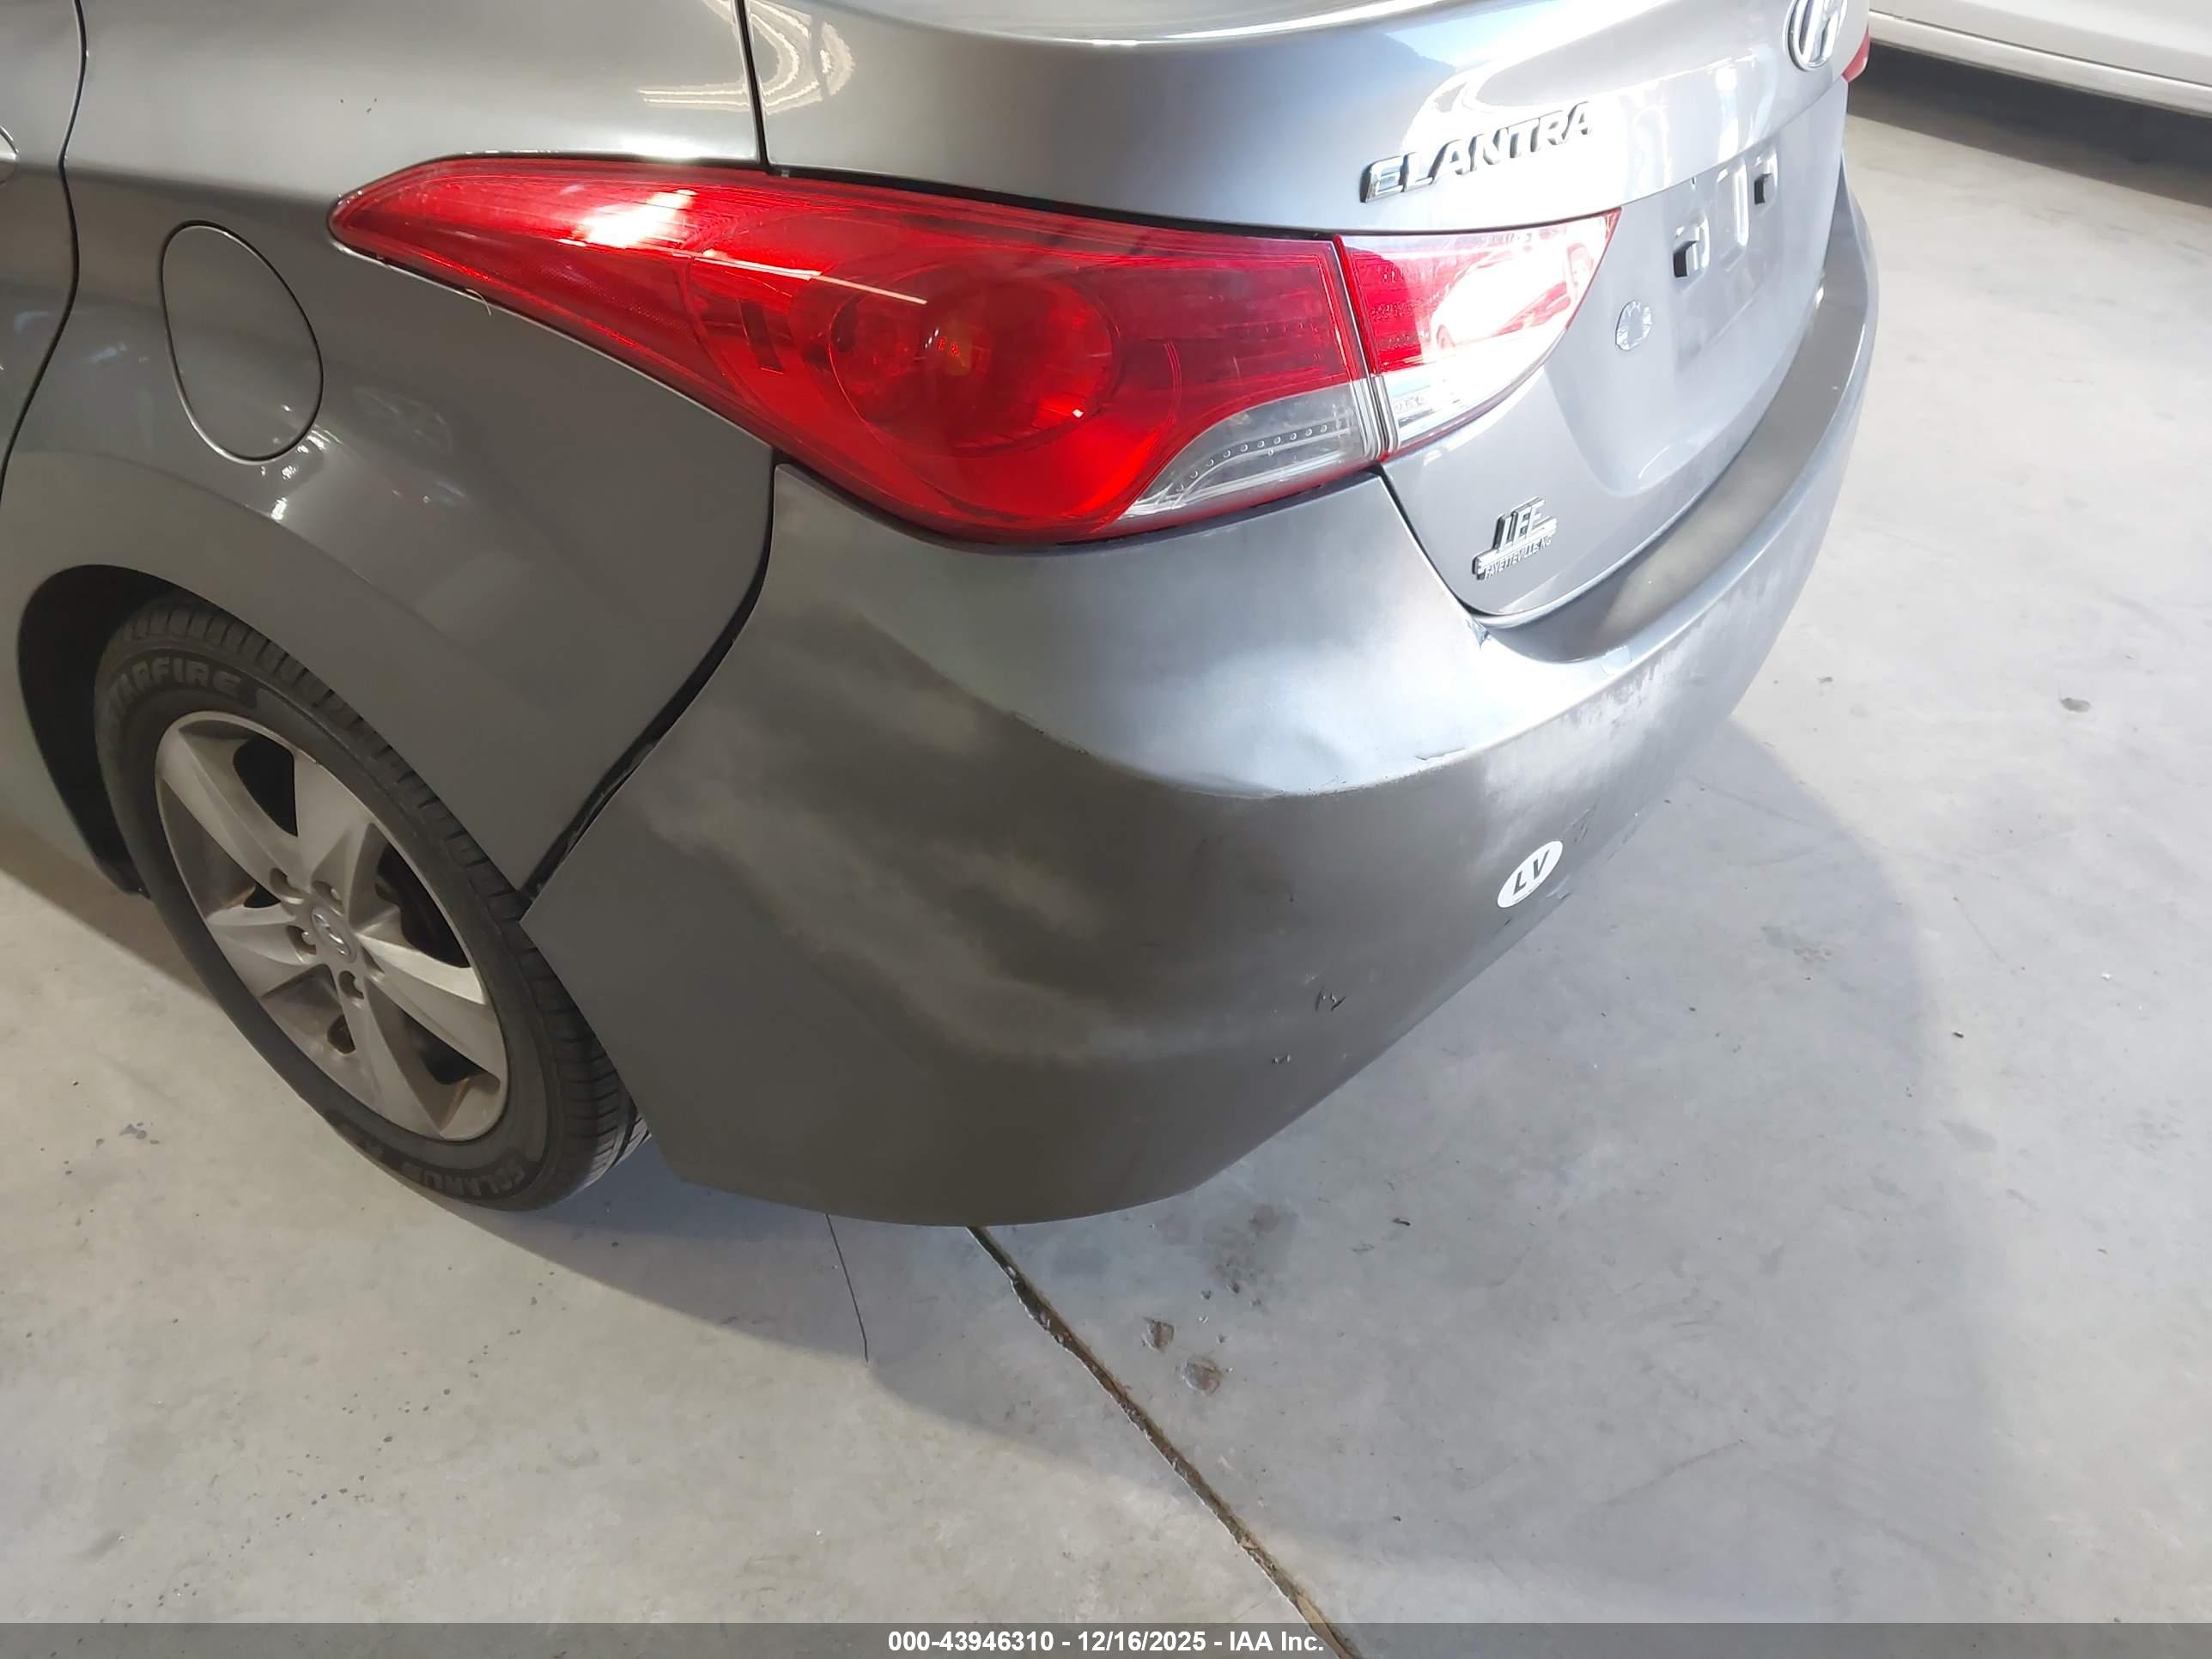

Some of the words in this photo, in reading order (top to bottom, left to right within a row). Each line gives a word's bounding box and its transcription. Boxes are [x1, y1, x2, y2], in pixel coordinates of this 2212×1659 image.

[1359, 100, 1593, 203] ELANTRA
[1492, 495, 1546, 552] LEE
[1513, 848, 1551, 896] LV
